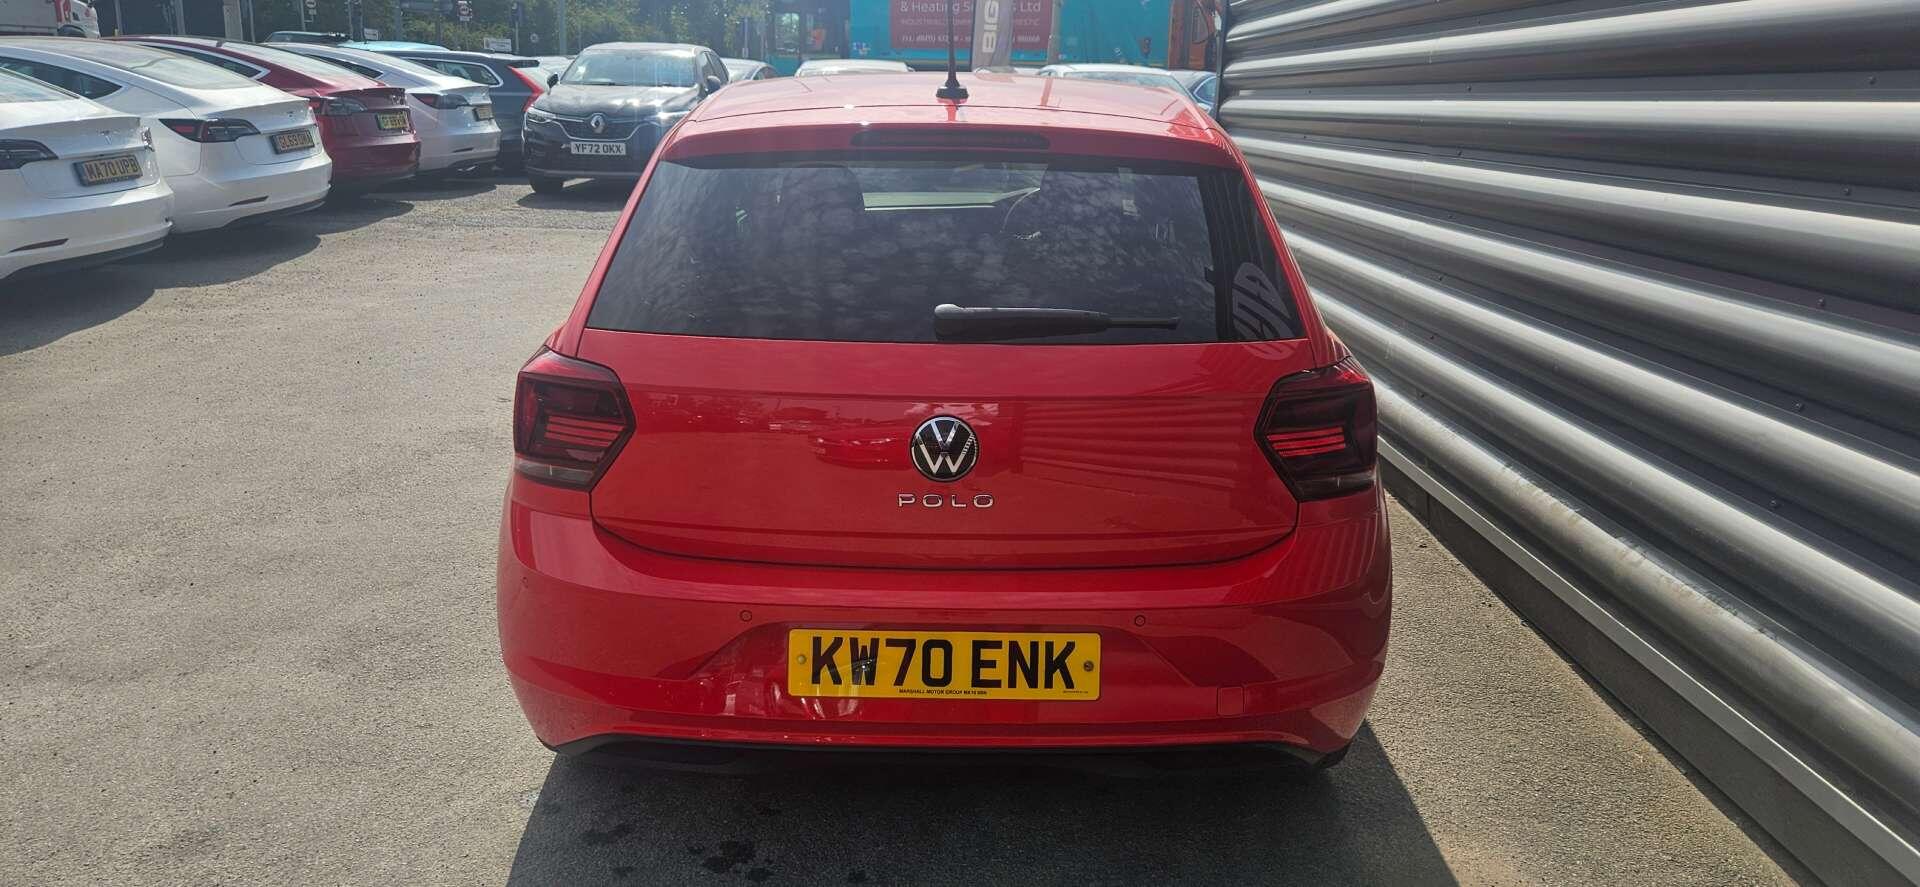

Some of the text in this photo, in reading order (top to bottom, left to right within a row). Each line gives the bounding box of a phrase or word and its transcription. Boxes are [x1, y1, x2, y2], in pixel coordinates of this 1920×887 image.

[900, 0, 909, 12] &
[1020, 1, 1041, 12] Ltd
[575, 143, 601, 154] YF72
[898, 493, 994, 508] POLO
[811, 636, 1076, 689] KW70 ENK
